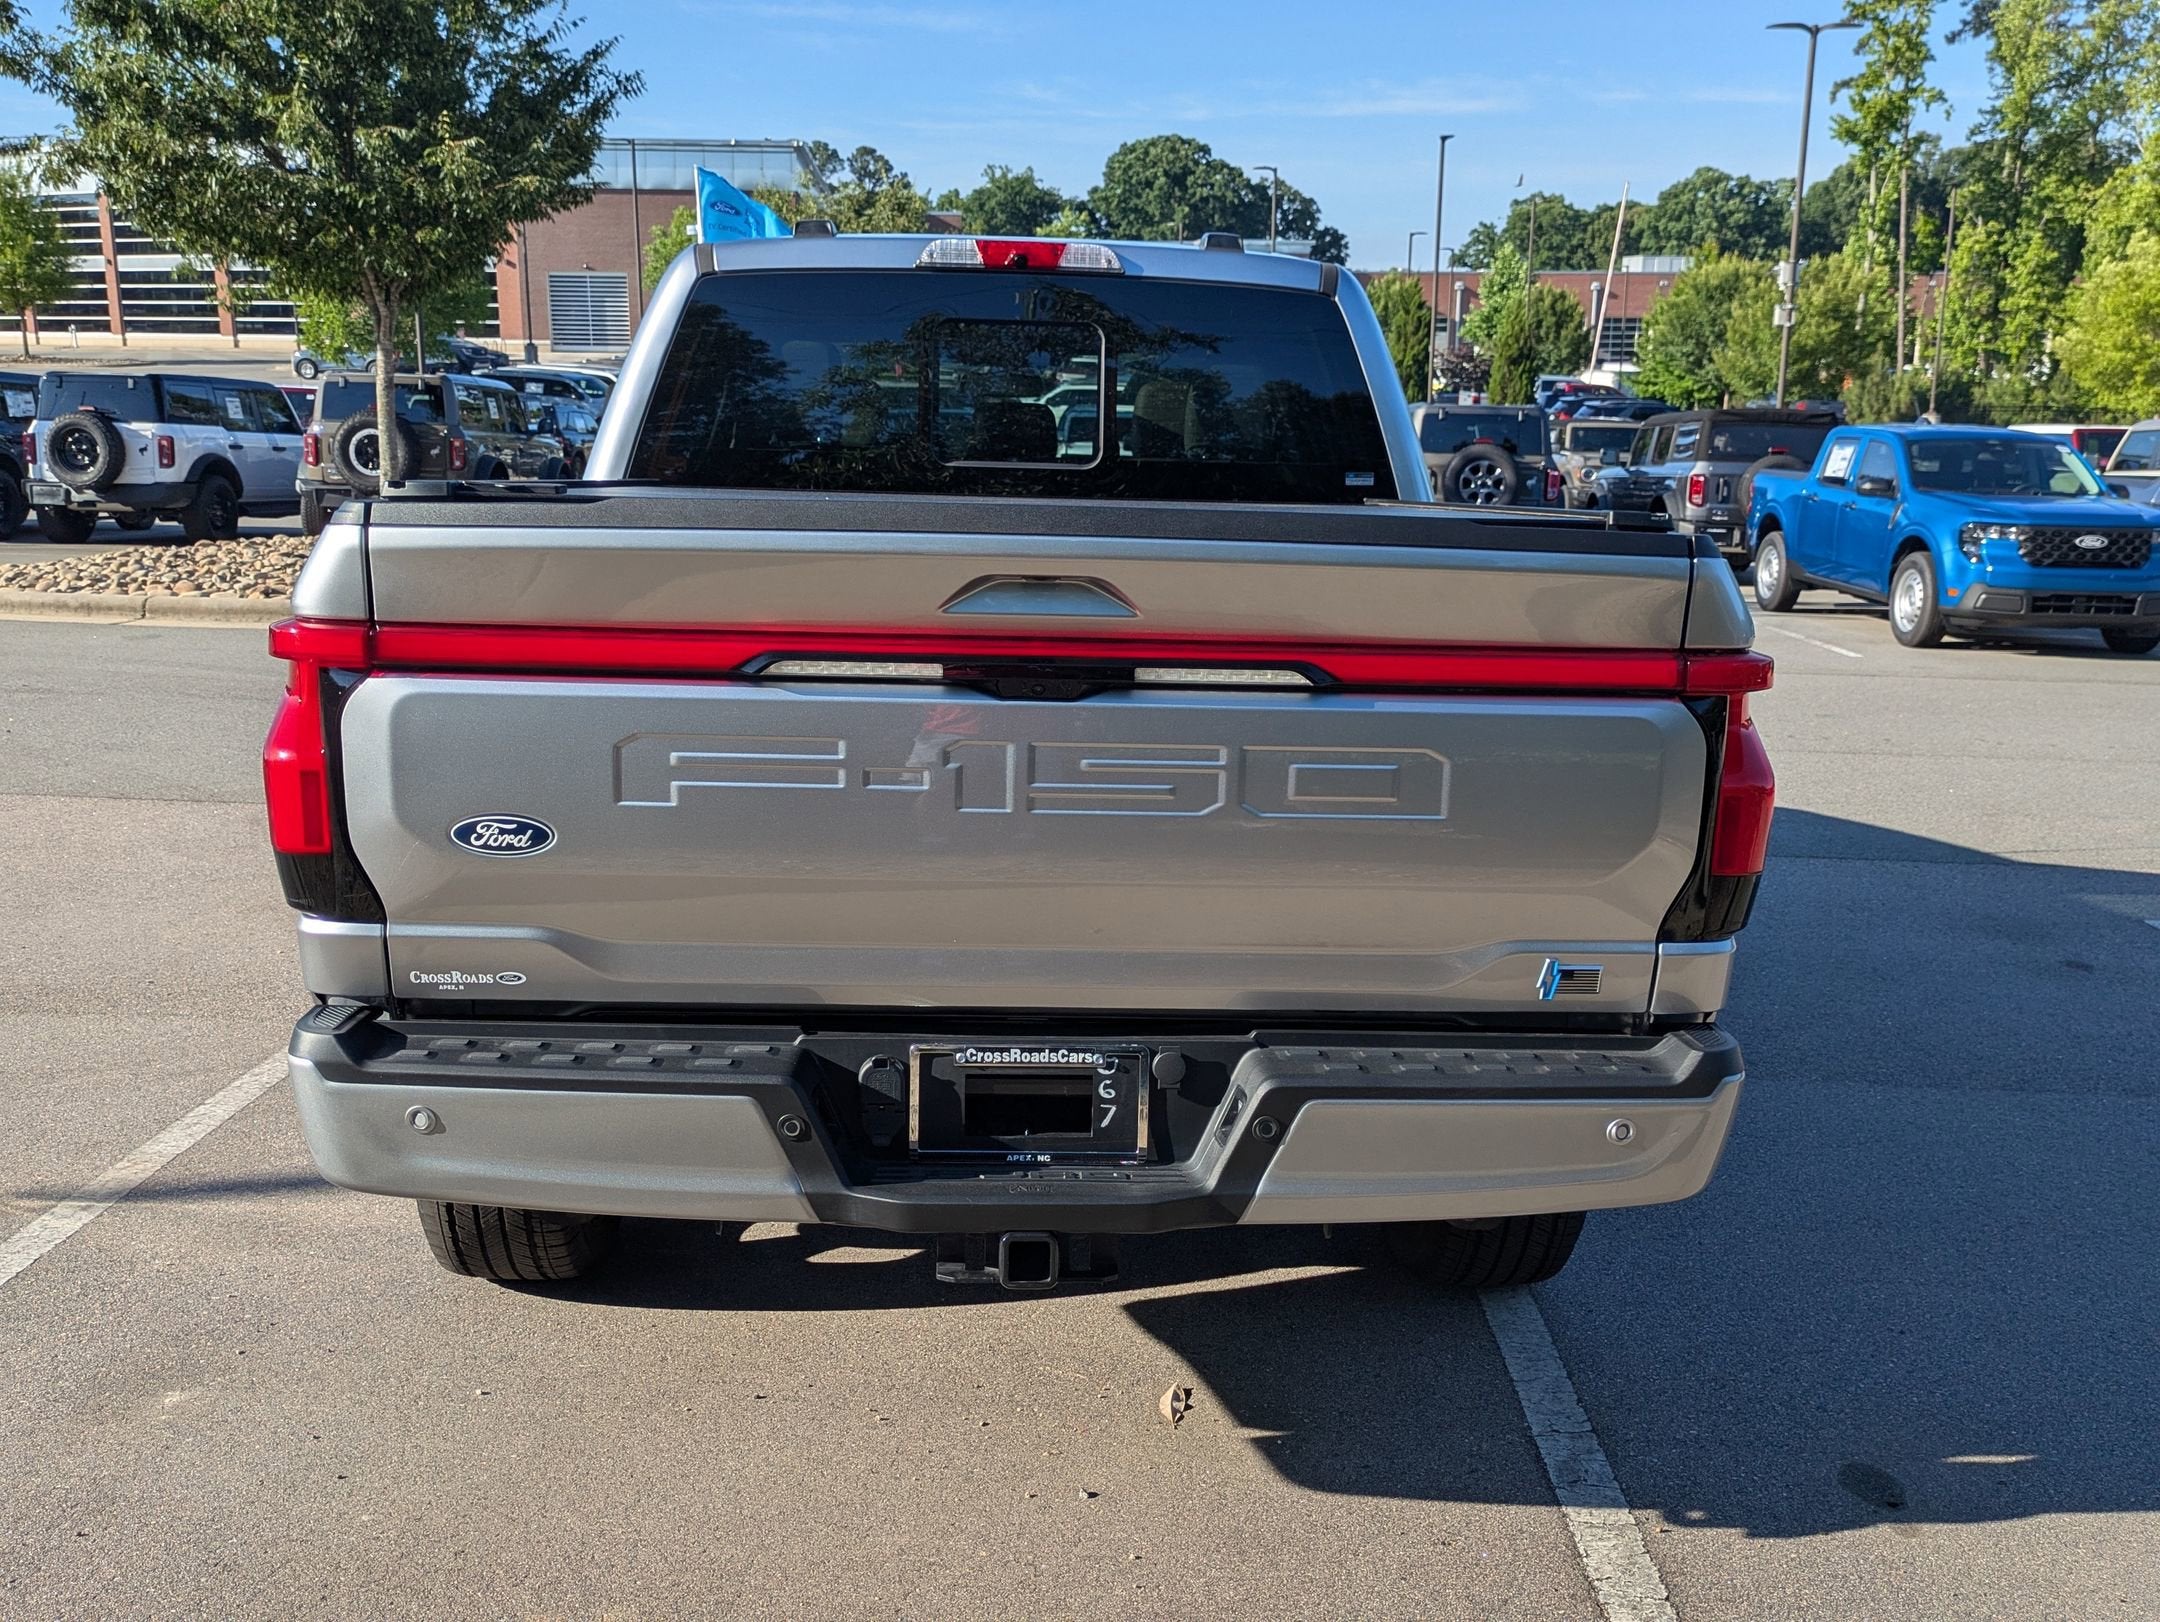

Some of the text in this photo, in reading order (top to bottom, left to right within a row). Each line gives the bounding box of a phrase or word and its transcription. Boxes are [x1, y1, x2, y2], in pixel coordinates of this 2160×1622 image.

[614, 731, 1450, 820] F-150
[470, 821, 534, 848] Ford
[965, 1048, 1094, 1064] CrossRoadsCars
[1037, 1154, 1051, 1162] NC
